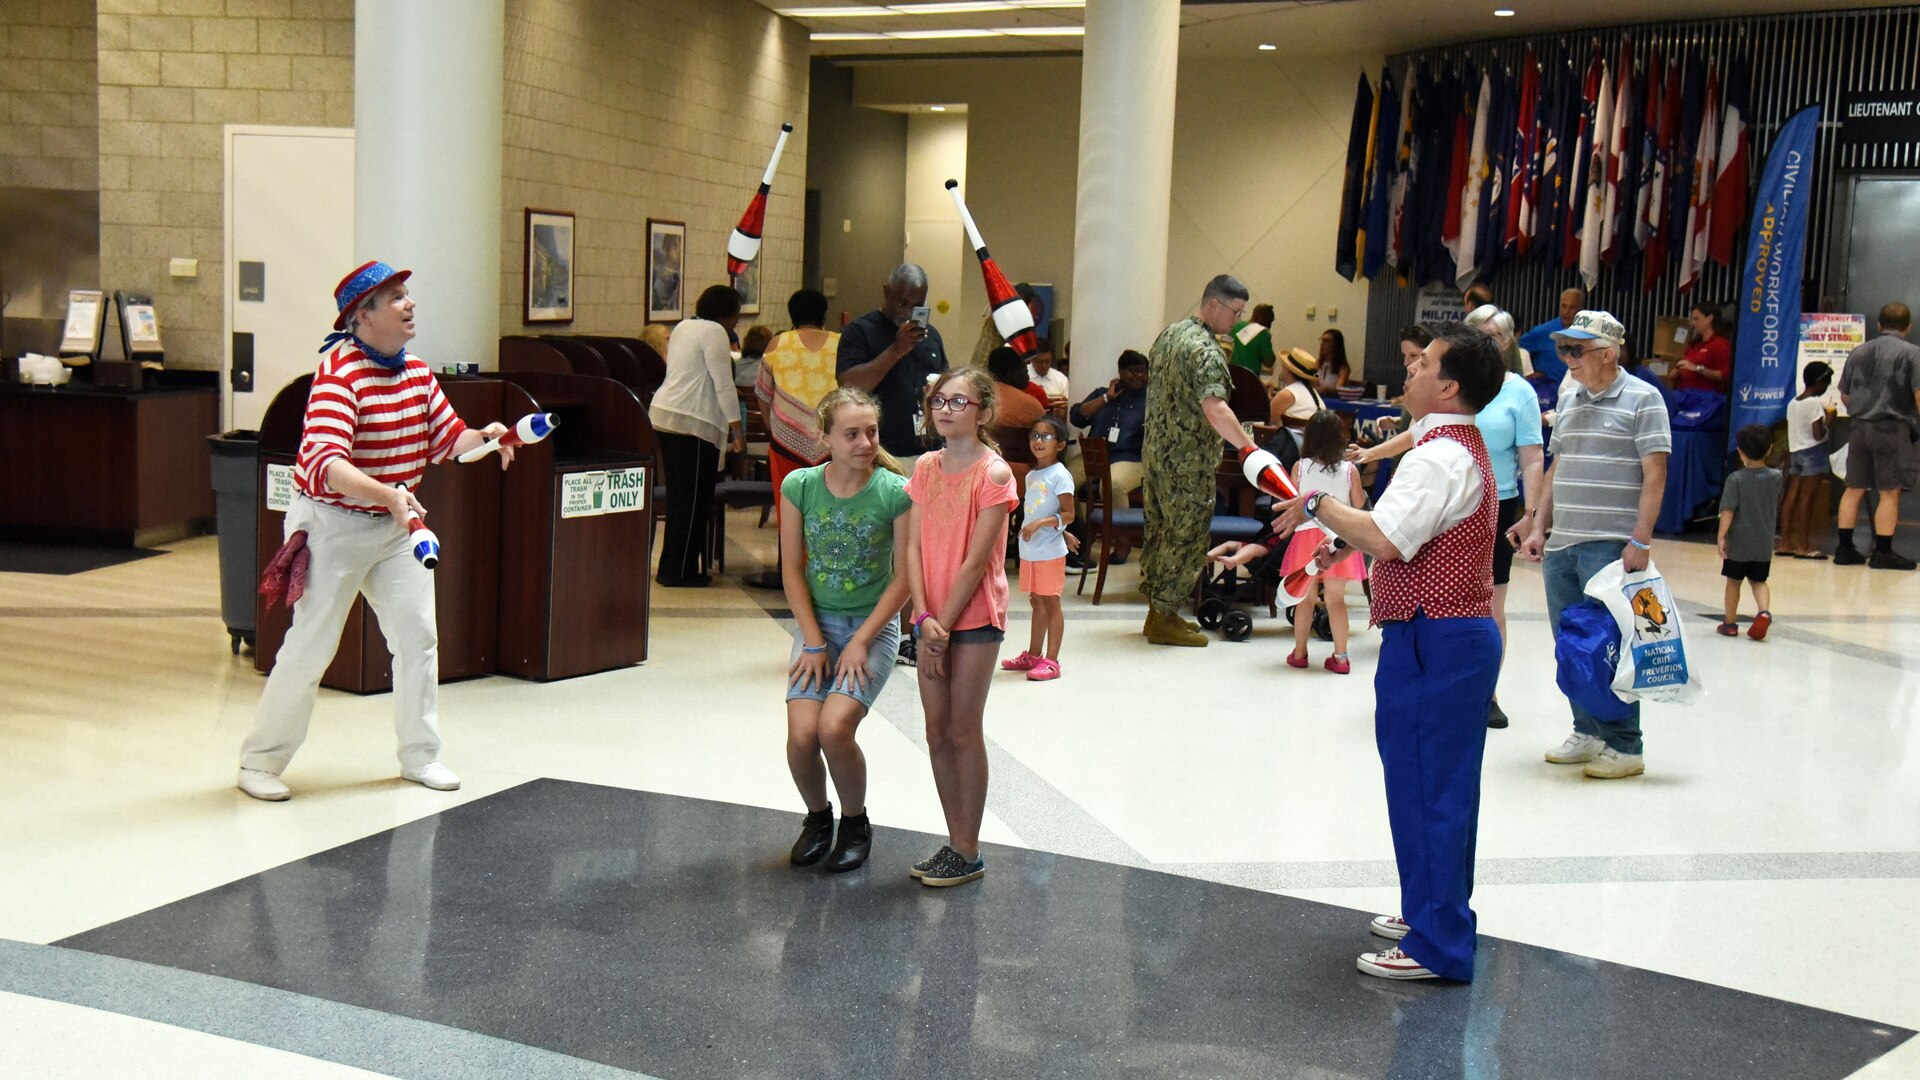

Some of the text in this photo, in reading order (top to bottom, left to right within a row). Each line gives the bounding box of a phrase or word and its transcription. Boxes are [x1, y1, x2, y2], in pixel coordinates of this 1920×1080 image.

[1848, 101, 1913, 117] LIEUTENANT
[1751, 202, 1775, 313] APPROVED
[1761, 242, 1783, 369] WORKFORCE
[1421, 309, 1467, 321] MILITAR
[1753, 391, 1785, 400] POWER
[269, 470, 286, 478] PLACE
[274, 478, 292, 486] TRASH
[564, 478, 582, 486] PLACE
[607, 472, 644, 490] TRASH
[269, 497, 290, 505] CONTAIN
[610, 490, 639, 508] ONLY
[563, 505, 592, 513] CONTAINER
[1645, 645, 1676, 657] NATIOAL
